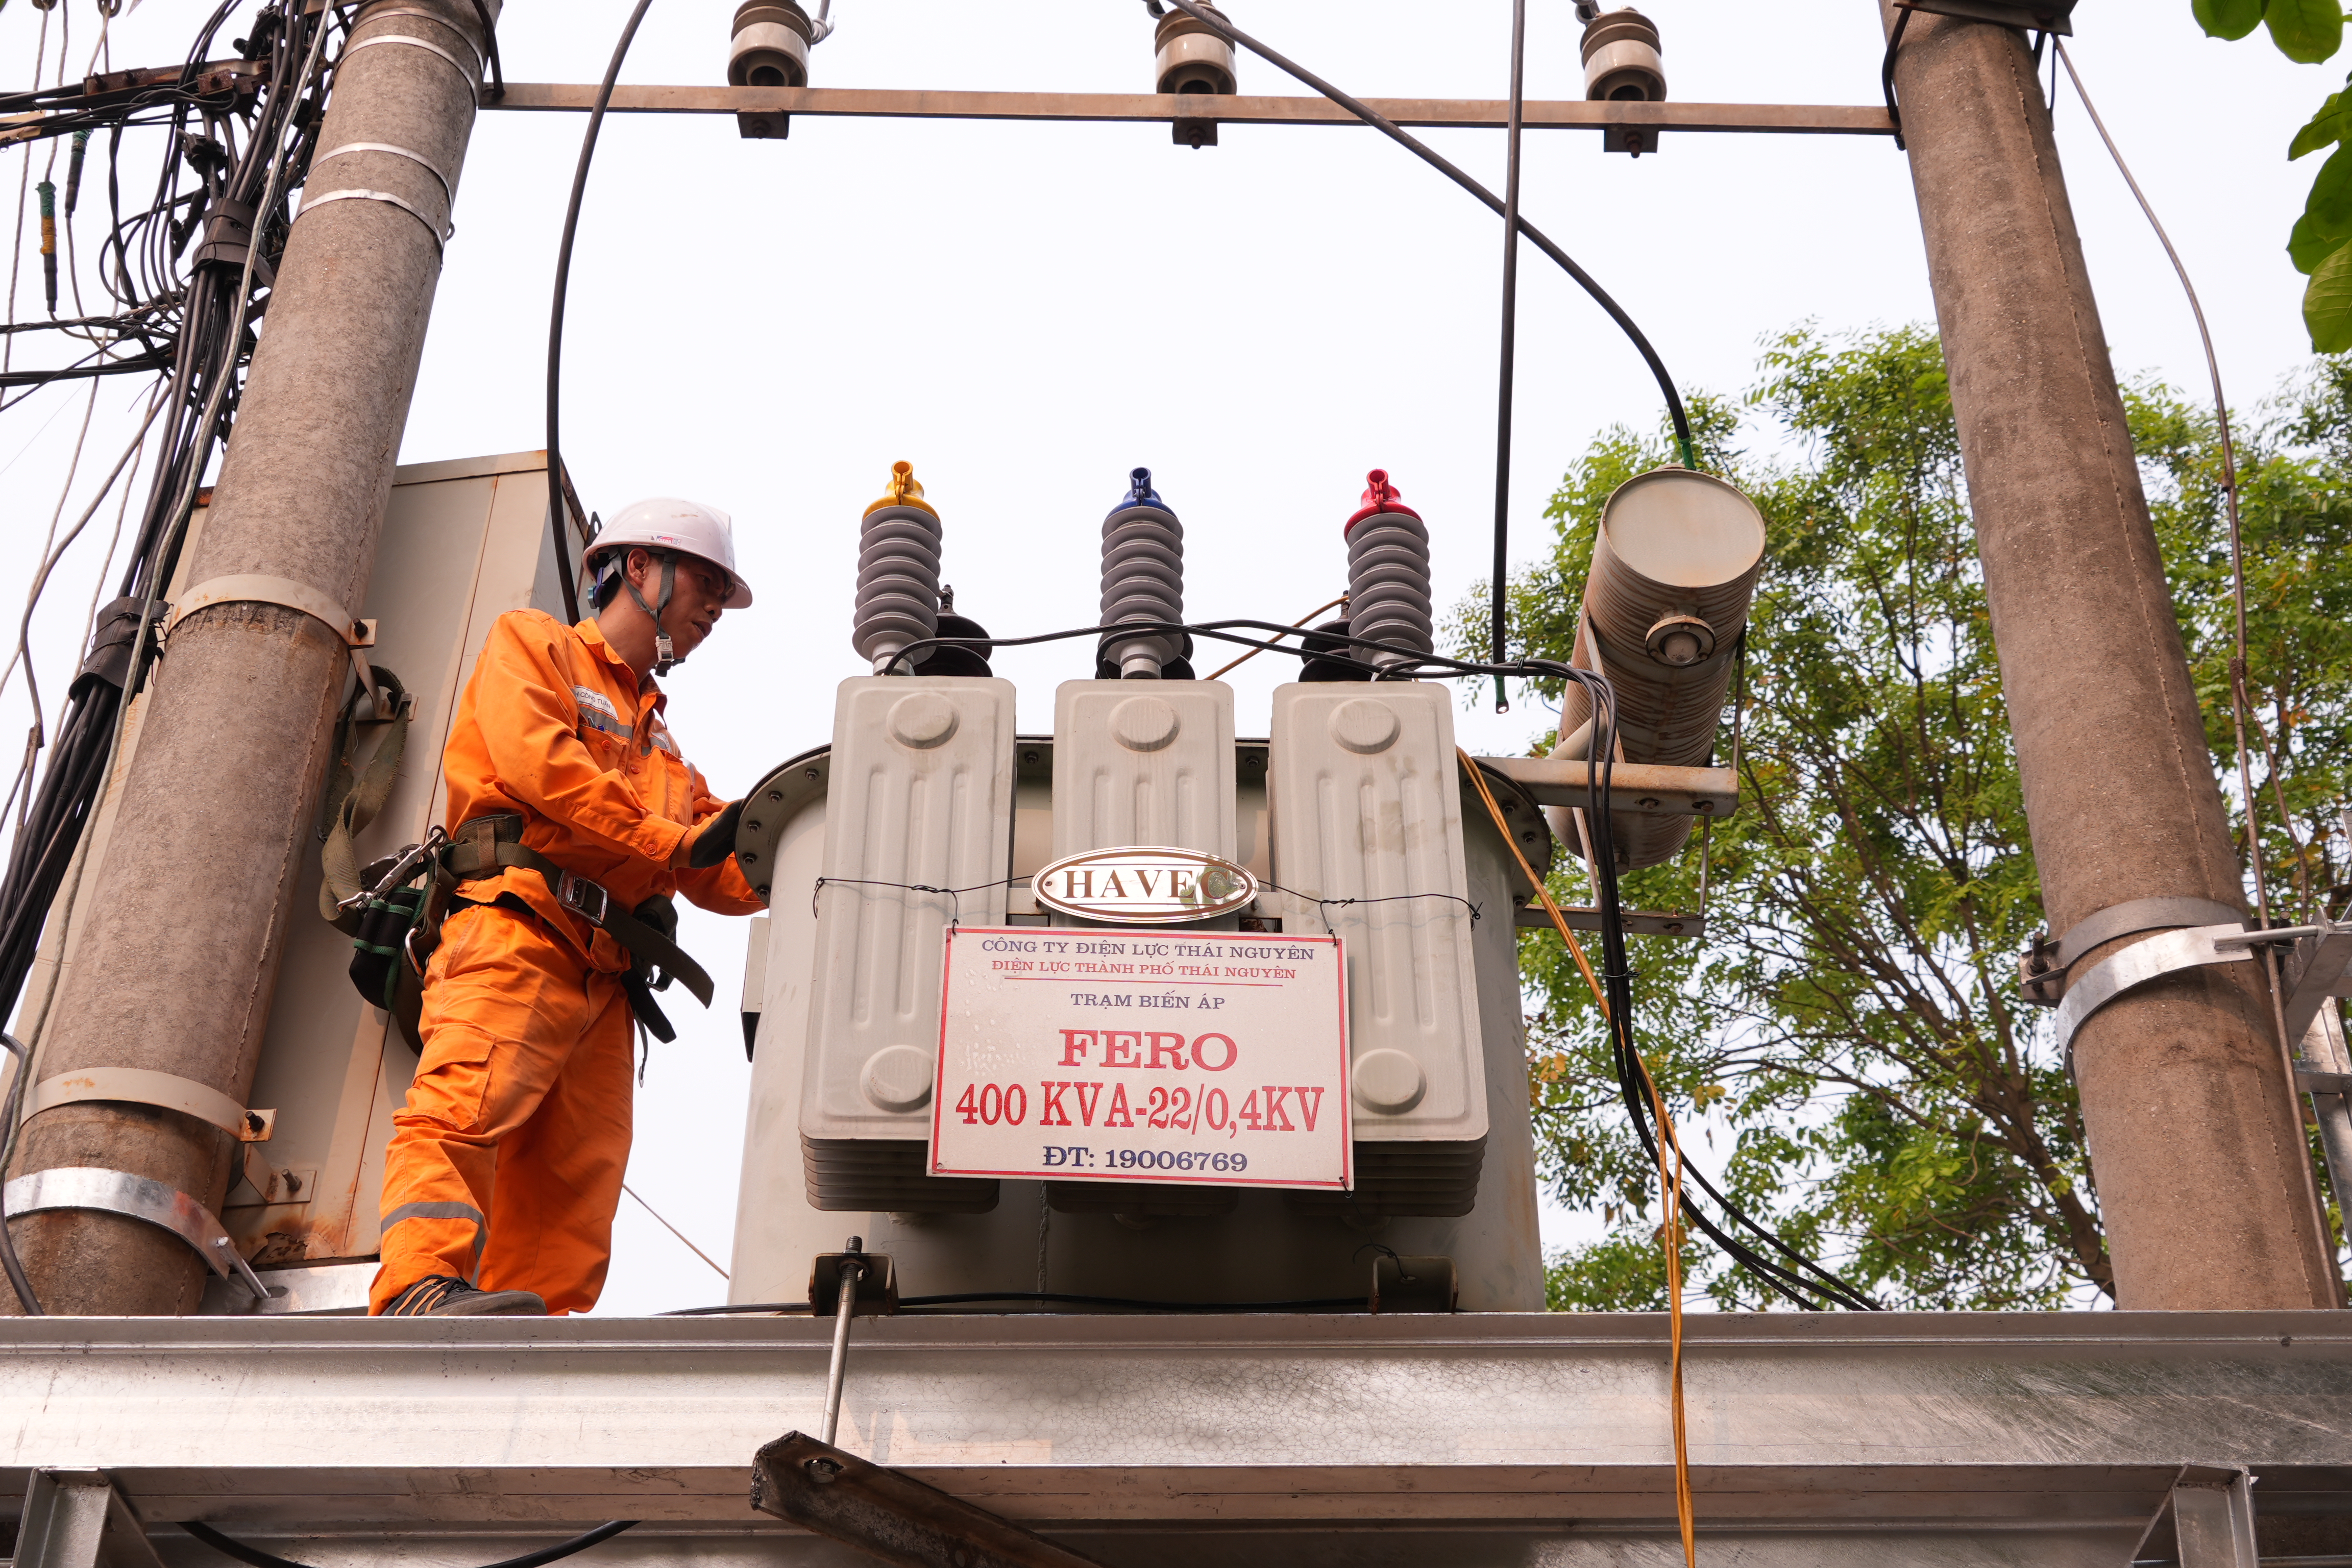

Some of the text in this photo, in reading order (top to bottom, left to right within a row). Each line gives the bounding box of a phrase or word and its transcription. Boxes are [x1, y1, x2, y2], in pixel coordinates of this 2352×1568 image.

[580, 692, 595, 702] CÔNG
[1063, 867, 1229, 900] HAVEC
[982, 937, 1314, 960] CÔNG TY ĐIỆN LỰC THÁI NGUYÊN
[992, 958, 1296, 979] ĐIỆN LỰC THÀNH PHỐ THÁI NGUYÊN
[1071, 990, 1225, 1010] TRẠM BIẾN ÁP
[1058, 1030, 1238, 1071] FERO
[956, 1081, 1325, 1139] 400 KVA-22/0,4KV
[1042, 1146, 1247, 1172] ĐT: 19006769
